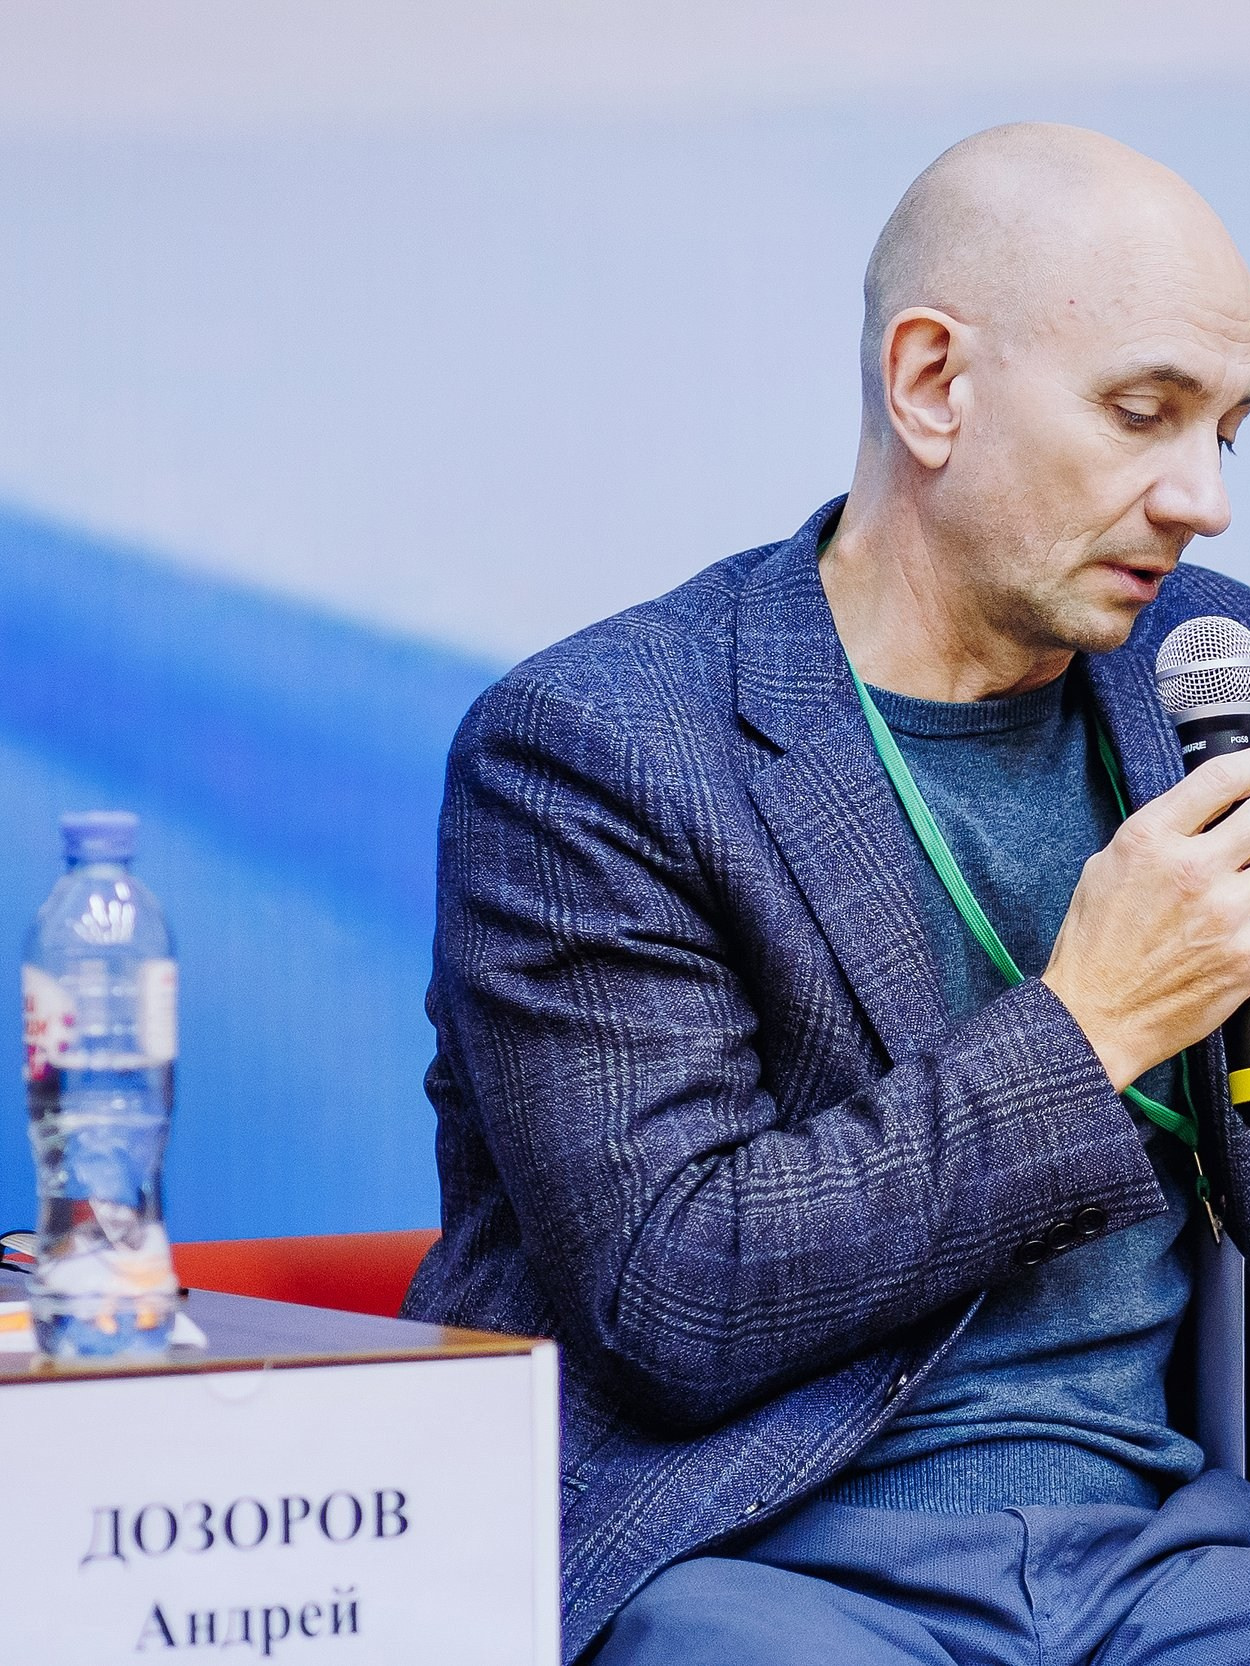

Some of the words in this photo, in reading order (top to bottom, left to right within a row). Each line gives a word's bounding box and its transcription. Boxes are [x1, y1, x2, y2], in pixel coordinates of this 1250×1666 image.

[1230, 735, 1249, 744] PG58
[79, 1488, 411, 1571] ДОЗОРОВ
[134, 1585, 361, 1658] Андрей
